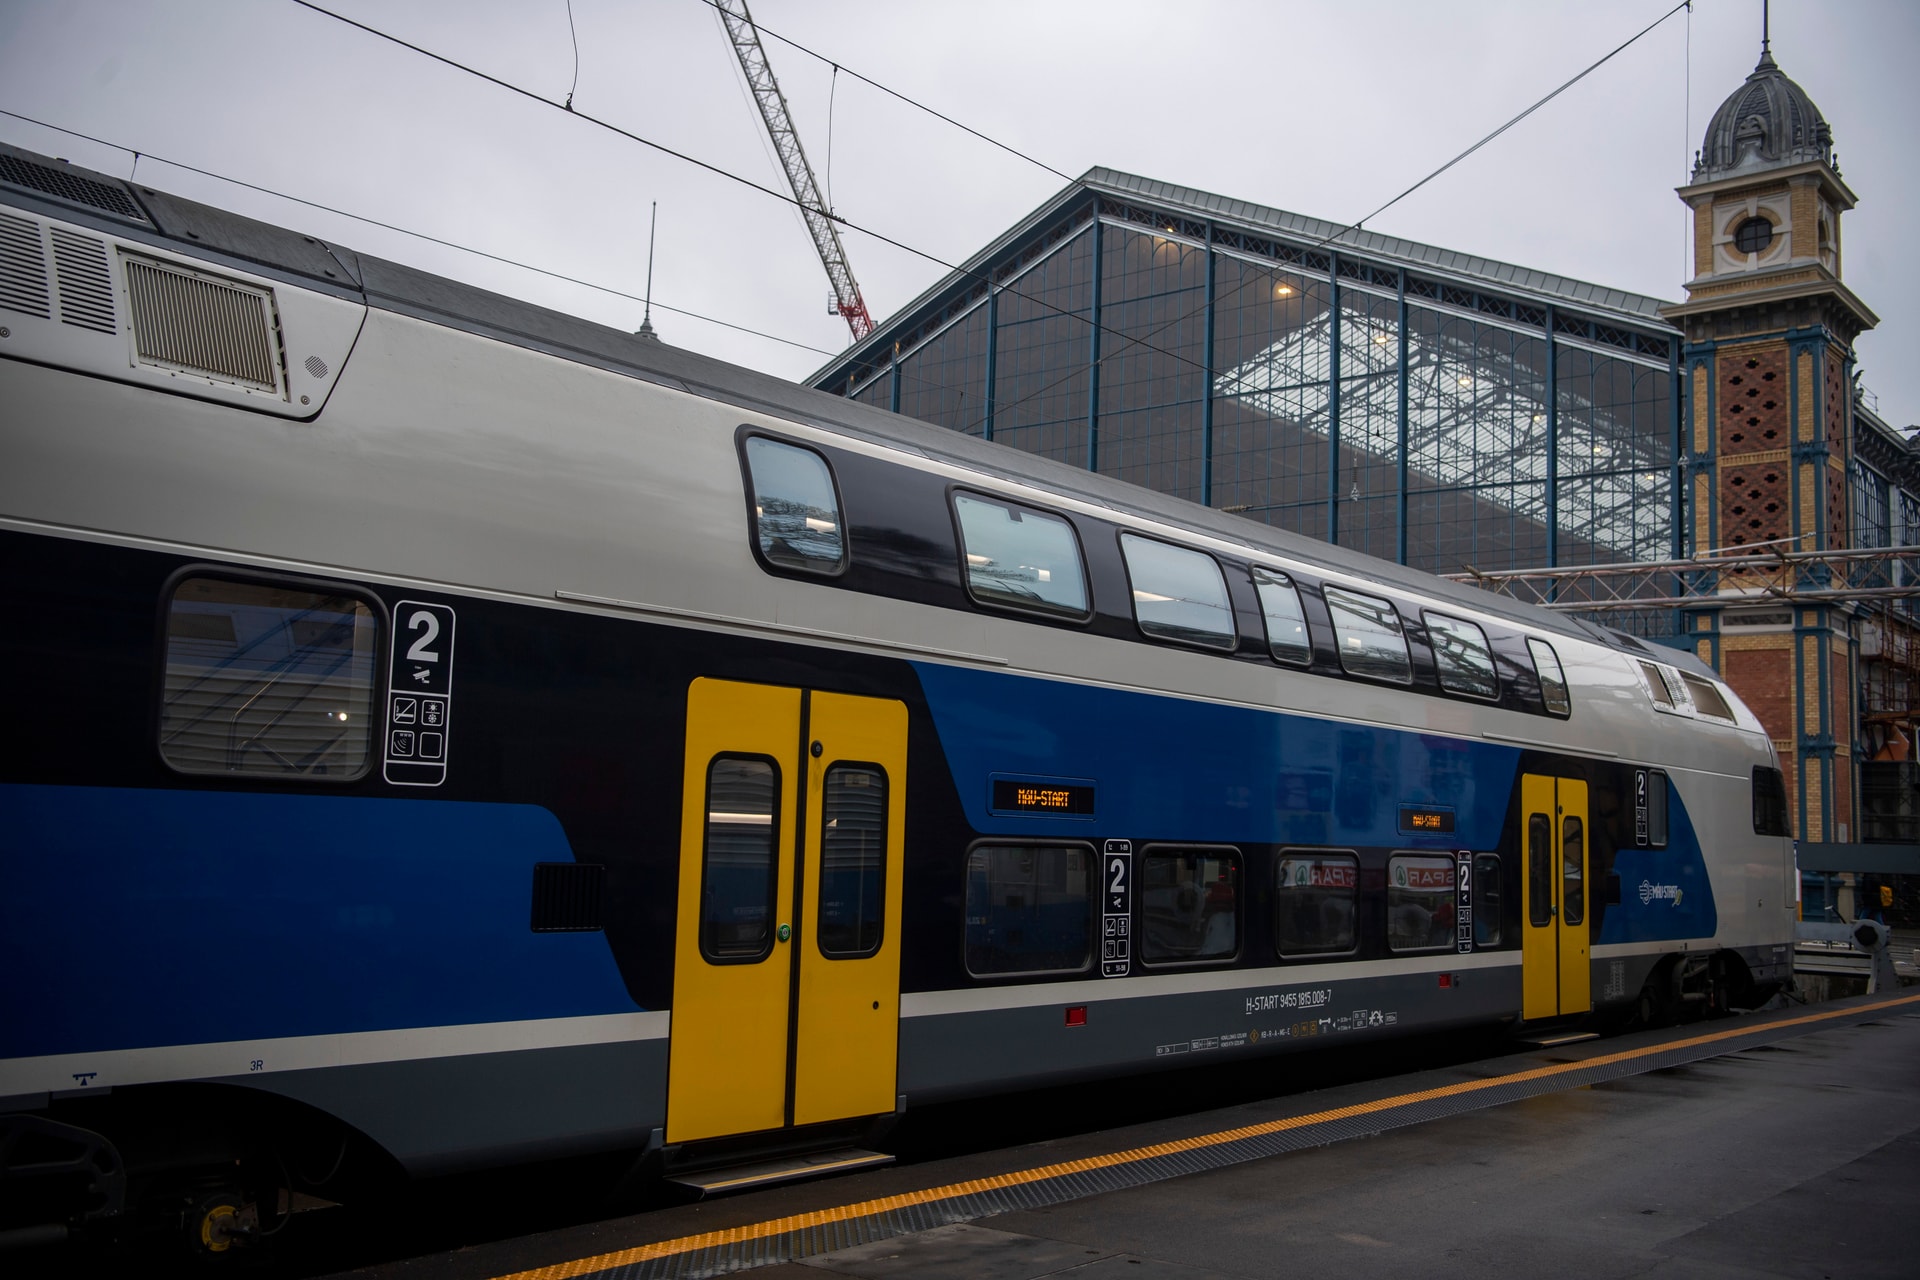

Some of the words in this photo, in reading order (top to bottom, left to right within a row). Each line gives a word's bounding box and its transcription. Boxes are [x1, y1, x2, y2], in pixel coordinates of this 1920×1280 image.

[406, 610, 440, 663] 2
[1637, 773, 1645, 796] 2
[1110, 858, 1125, 893] 2
[1460, 864, 1470, 891] 2
[1246, 995, 1279, 1014] H-START
[1280, 993, 1297, 1008] 9455
[1298, 992, 1311, 1008] 1815
[1312, 989, 1331, 1006] 008-7
[250, 1060, 264, 1071] 3R
